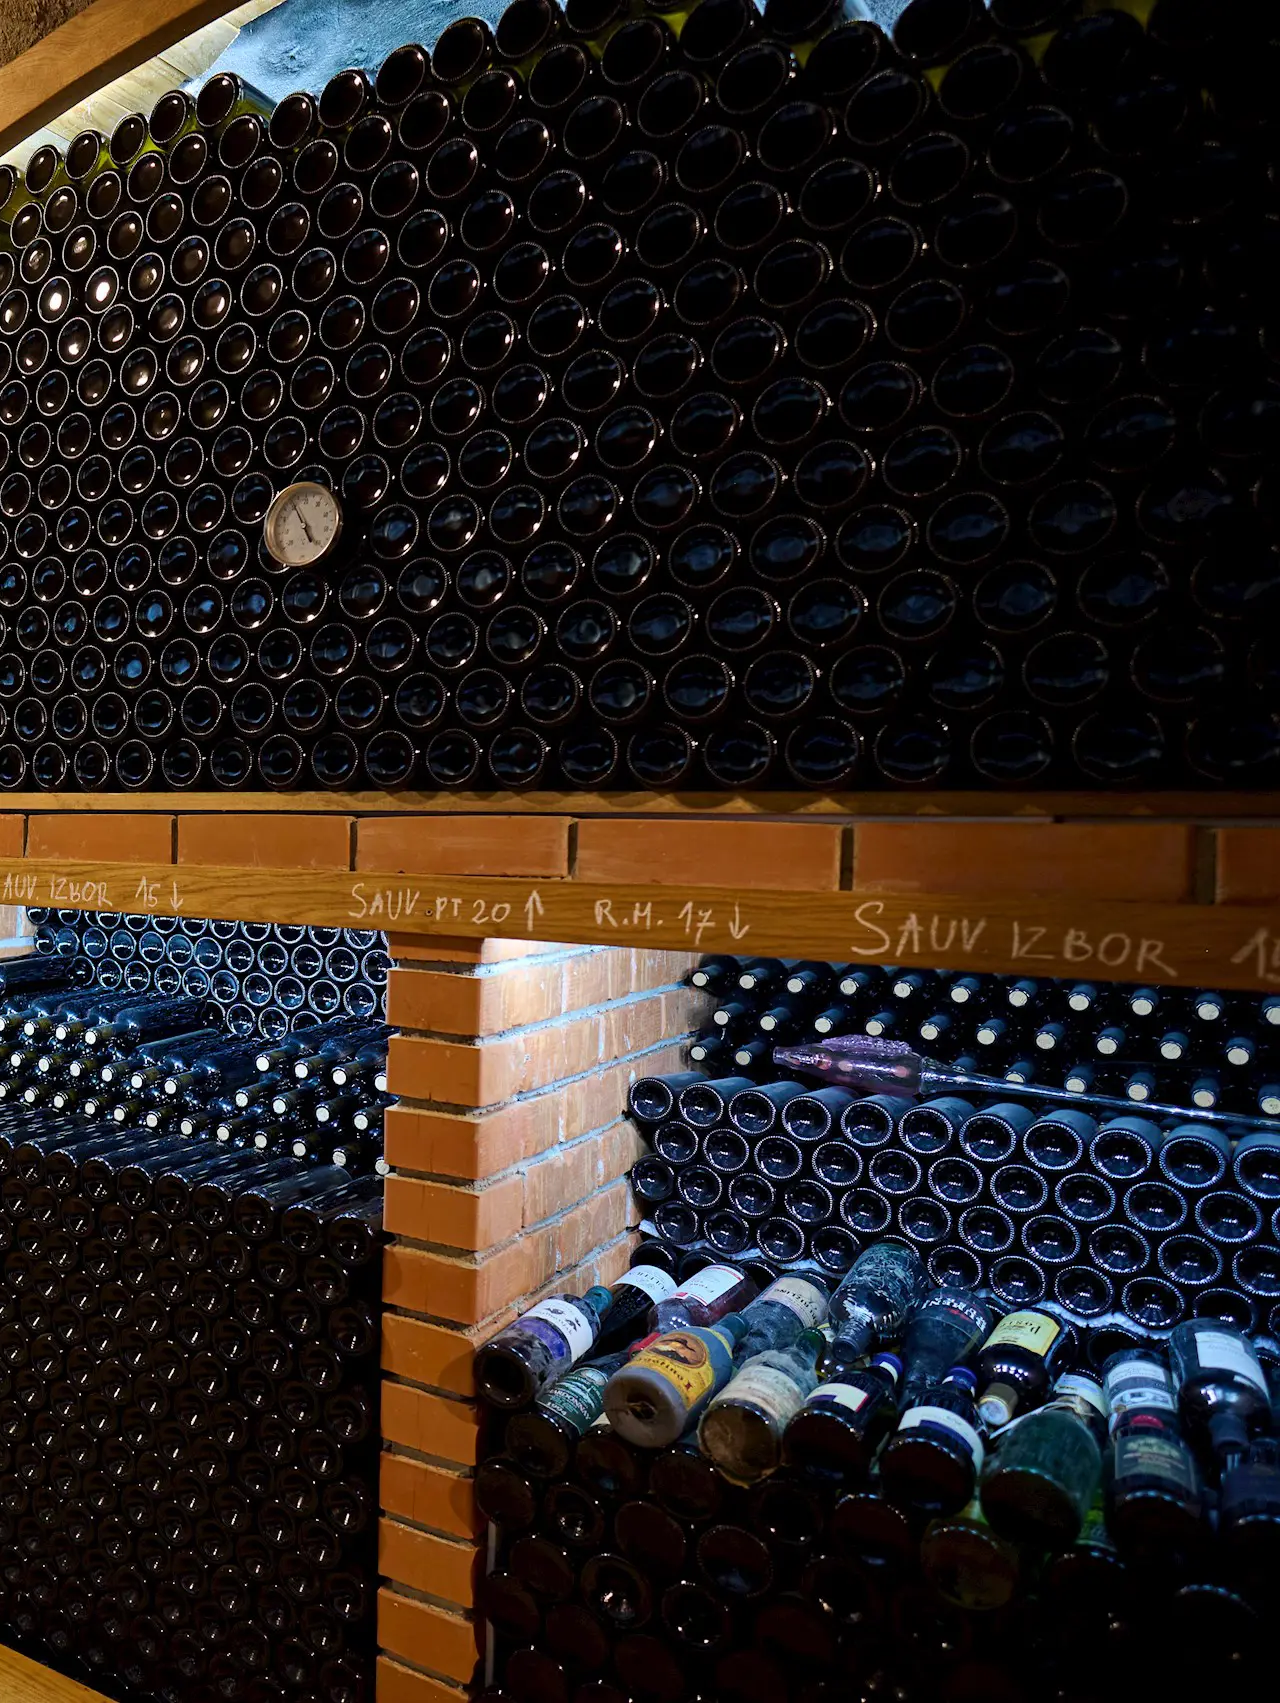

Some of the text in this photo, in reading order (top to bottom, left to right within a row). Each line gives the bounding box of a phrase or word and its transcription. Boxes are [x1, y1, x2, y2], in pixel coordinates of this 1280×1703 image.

[135, 875, 161, 908] 15
[472, 899, 511, 924] 20
[677, 901, 716, 946] 17
[1011, 920, 1179, 978] IZBOR
